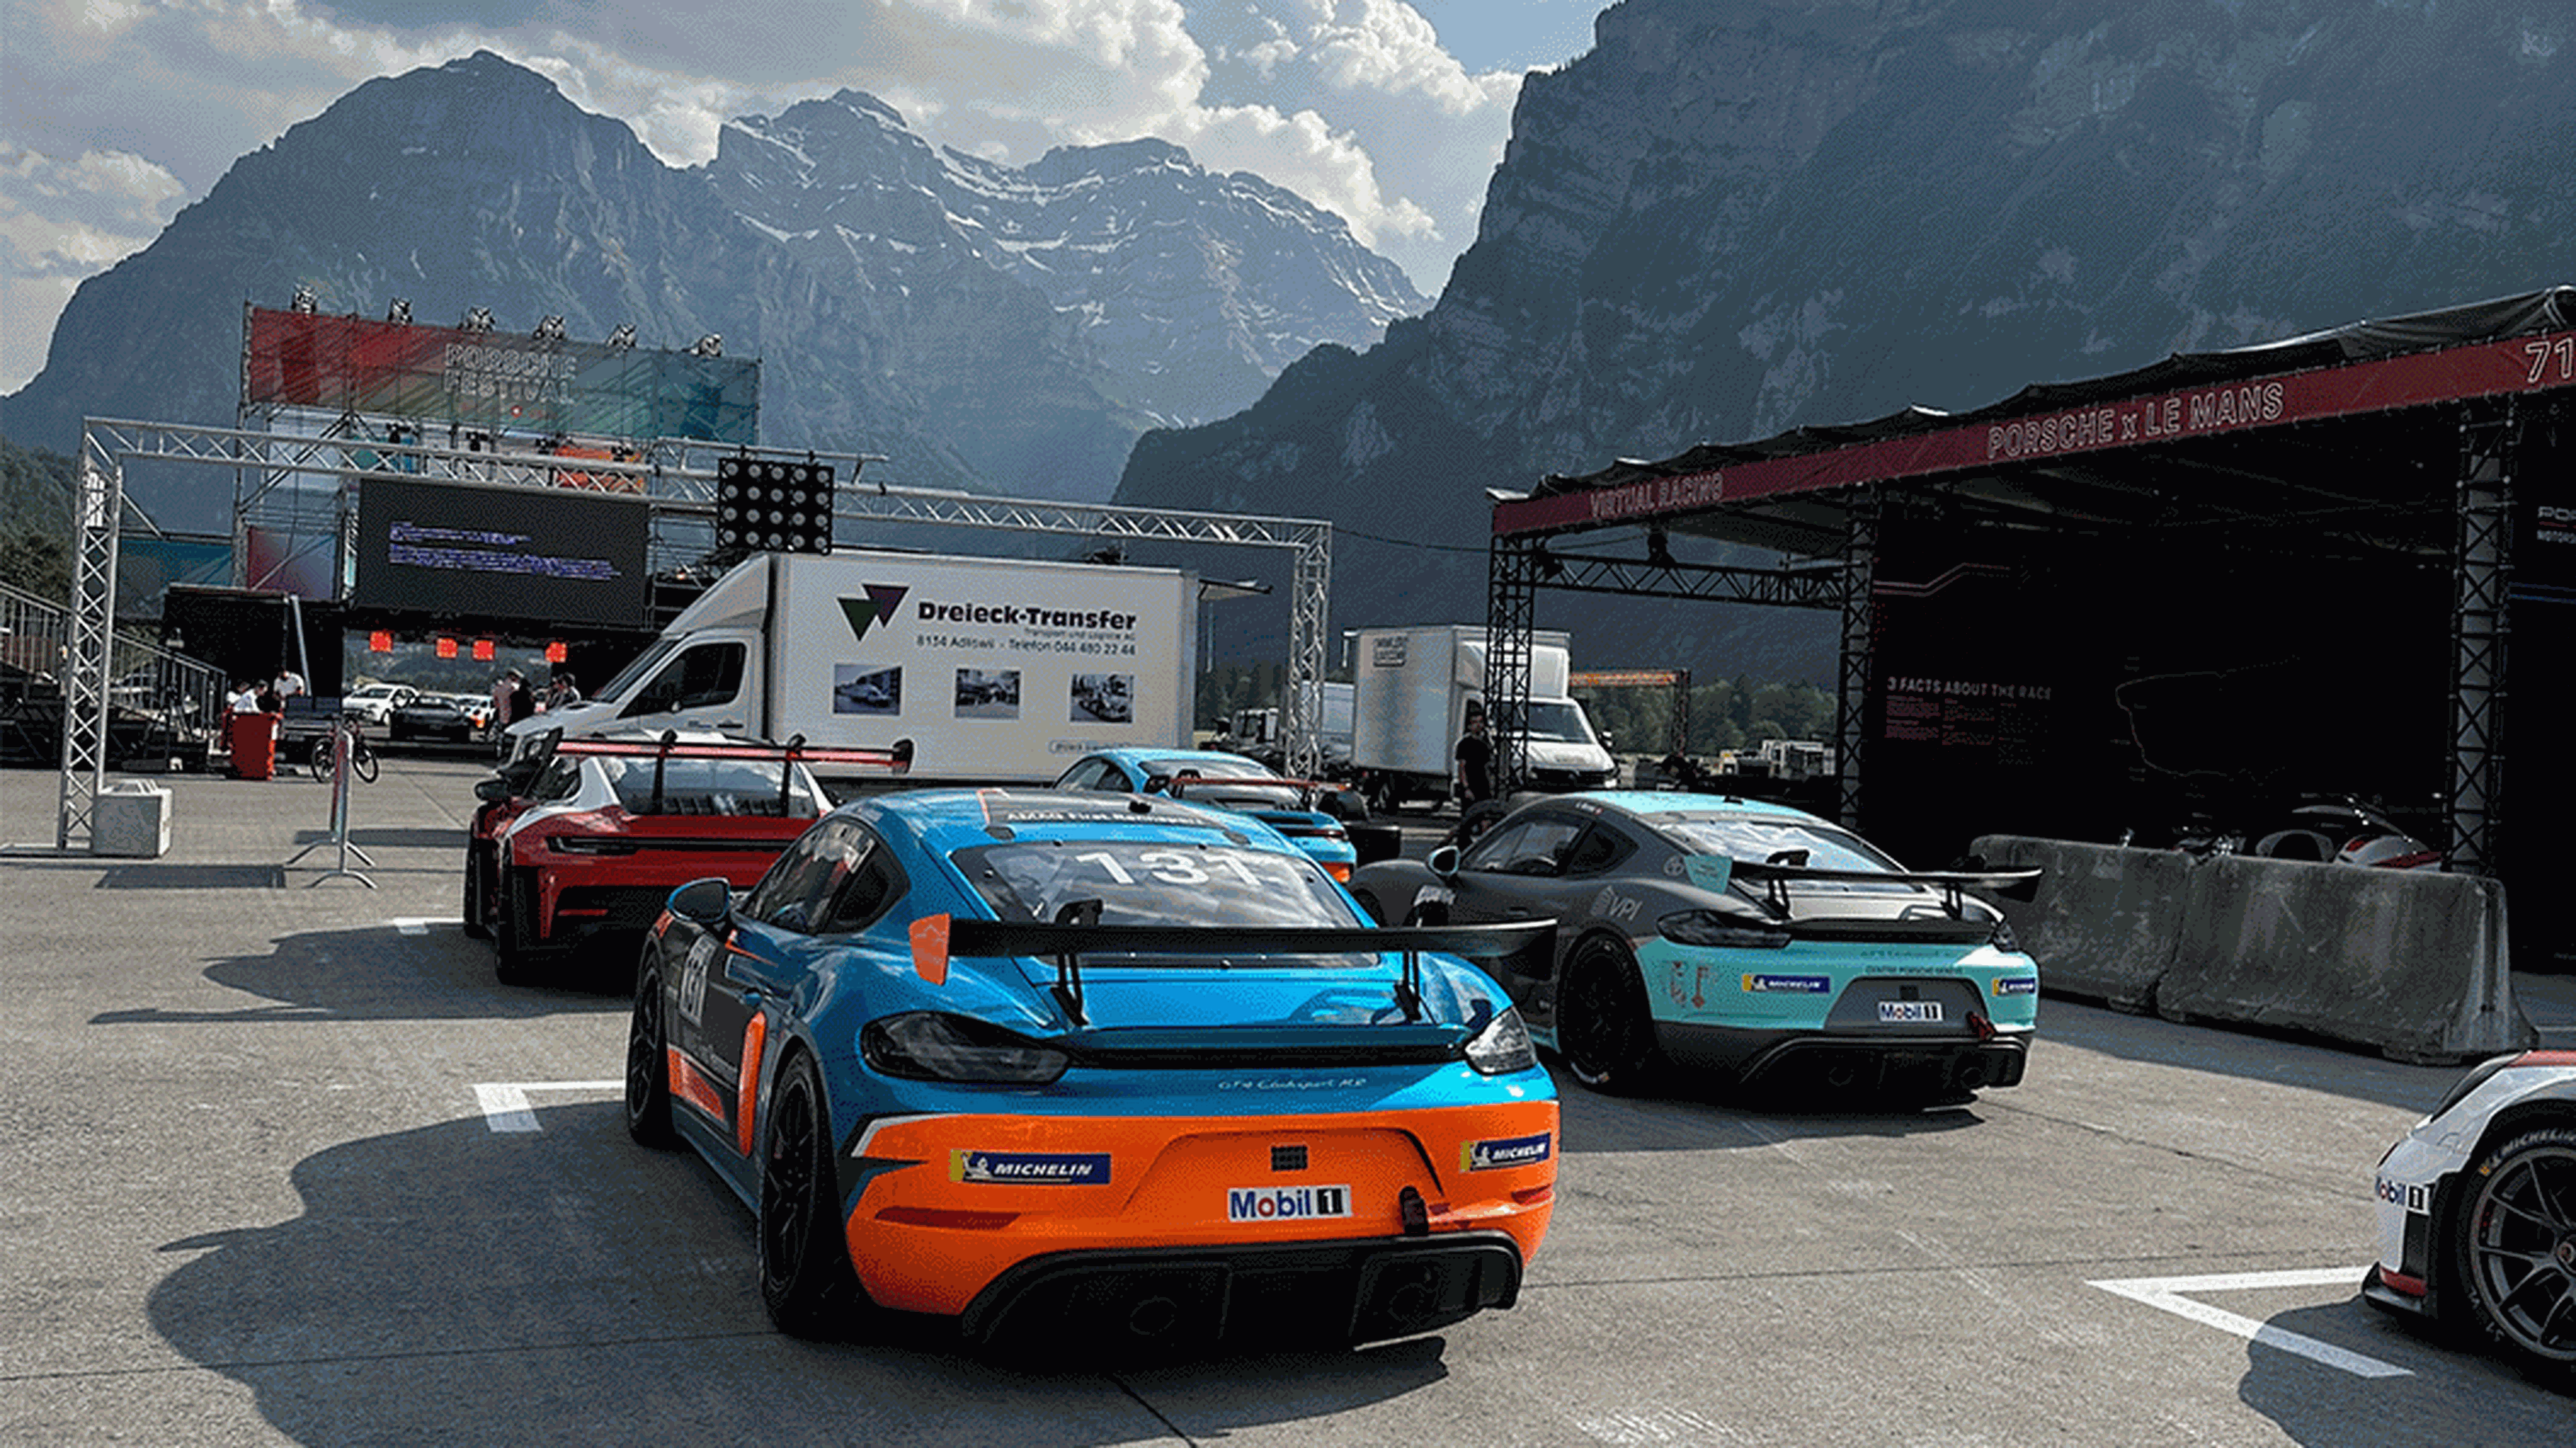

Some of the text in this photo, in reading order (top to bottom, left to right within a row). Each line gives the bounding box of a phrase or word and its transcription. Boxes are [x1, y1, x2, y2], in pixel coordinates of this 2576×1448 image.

[1988, 408, 2116, 459] PORSCHE
[2146, 398, 2182, 436] LE
[2190, 382, 2284, 429] MANS
[1590, 471, 1723, 518] VIRTUAL RACING
[918, 602, 1137, 630] Dreieck-Transfer
[1009, 638, 1051, 651] Telefon
[1887, 676, 1898, 691] 3
[1898, 677, 1942, 693] FACTS
[1943, 680, 1988, 696] ABOUT
[1075, 852, 1263, 885] 131
[1880, 1004, 1921, 1019] Mobil
[994, 1163, 1093, 1176] MICHELIN
[1230, 1188, 1311, 1219] Mobil
